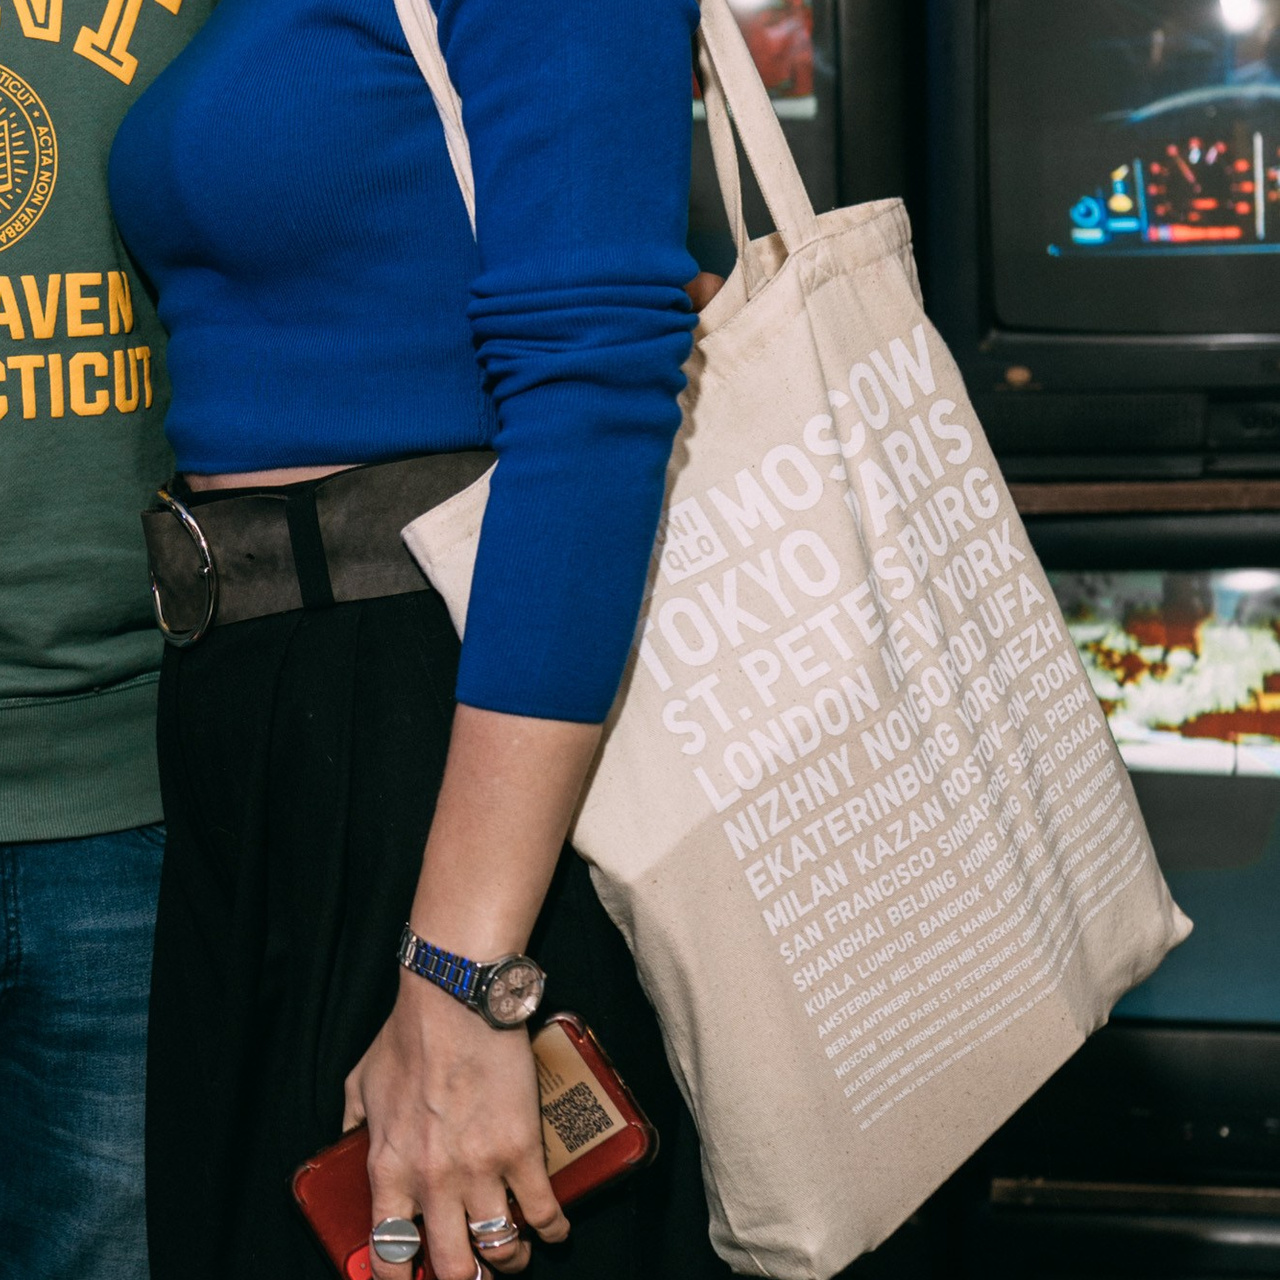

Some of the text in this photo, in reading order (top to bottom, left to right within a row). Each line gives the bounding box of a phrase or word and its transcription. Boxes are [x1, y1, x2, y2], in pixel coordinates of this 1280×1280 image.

[30, 171, 53, 207] NON
[36, 125, 53, 167] ACTA
[664, 534, 715, 572] QLO
[707, 323, 936, 548] MOSCOW
[637, 529, 842, 692] TOKYO
[662, 466, 1000, 757] ST. PETERSBURG
[692, 515, 1028, 812] LONDON NEW YORK
[723, 572, 1048, 860] NIZHNY NOVGOROD UFA
[744, 608, 1065, 900] EKATERINBURG VORONEZH
[762, 648, 1078, 935] MILAN KAZAN ROSTOV-ON-DON
[779, 682, 1090, 964] SAN FRANCISCO SINGAPORE SEOUL PERM
[793, 713, 1100, 991] SHANGHAI BEIJING HONG KONG TAIPEI OSAKA
[804, 973, 855, 1016] KUALA
[856, 931, 916, 978] LUMPUR
[918, 883, 983, 937] BANGKOK
[984, 819, 1036, 890] BARCELONA
[1065, 738, 1108, 788] JAKARTA
[817, 978, 887, 1038] AMSTERDAM
[889, 930, 960, 985] MELBOURNE
[960, 898, 1004, 936] MANILA
[1002, 872, 1024, 903] DELH
[825, 1025, 862, 1058] BERLIN
[863, 990, 910, 1031] ANTWERP
[941, 958, 958, 976] CHI
[976, 903, 1026, 952] STOCKHOLM
[834, 1040, 876, 1078] MOSCOW
[877, 1018, 908, 1044] TOKYO
[909, 997, 938, 1023] PARIS
[939, 988, 955, 1002] ST.
[954, 942, 1017, 992] PETERSBURG
